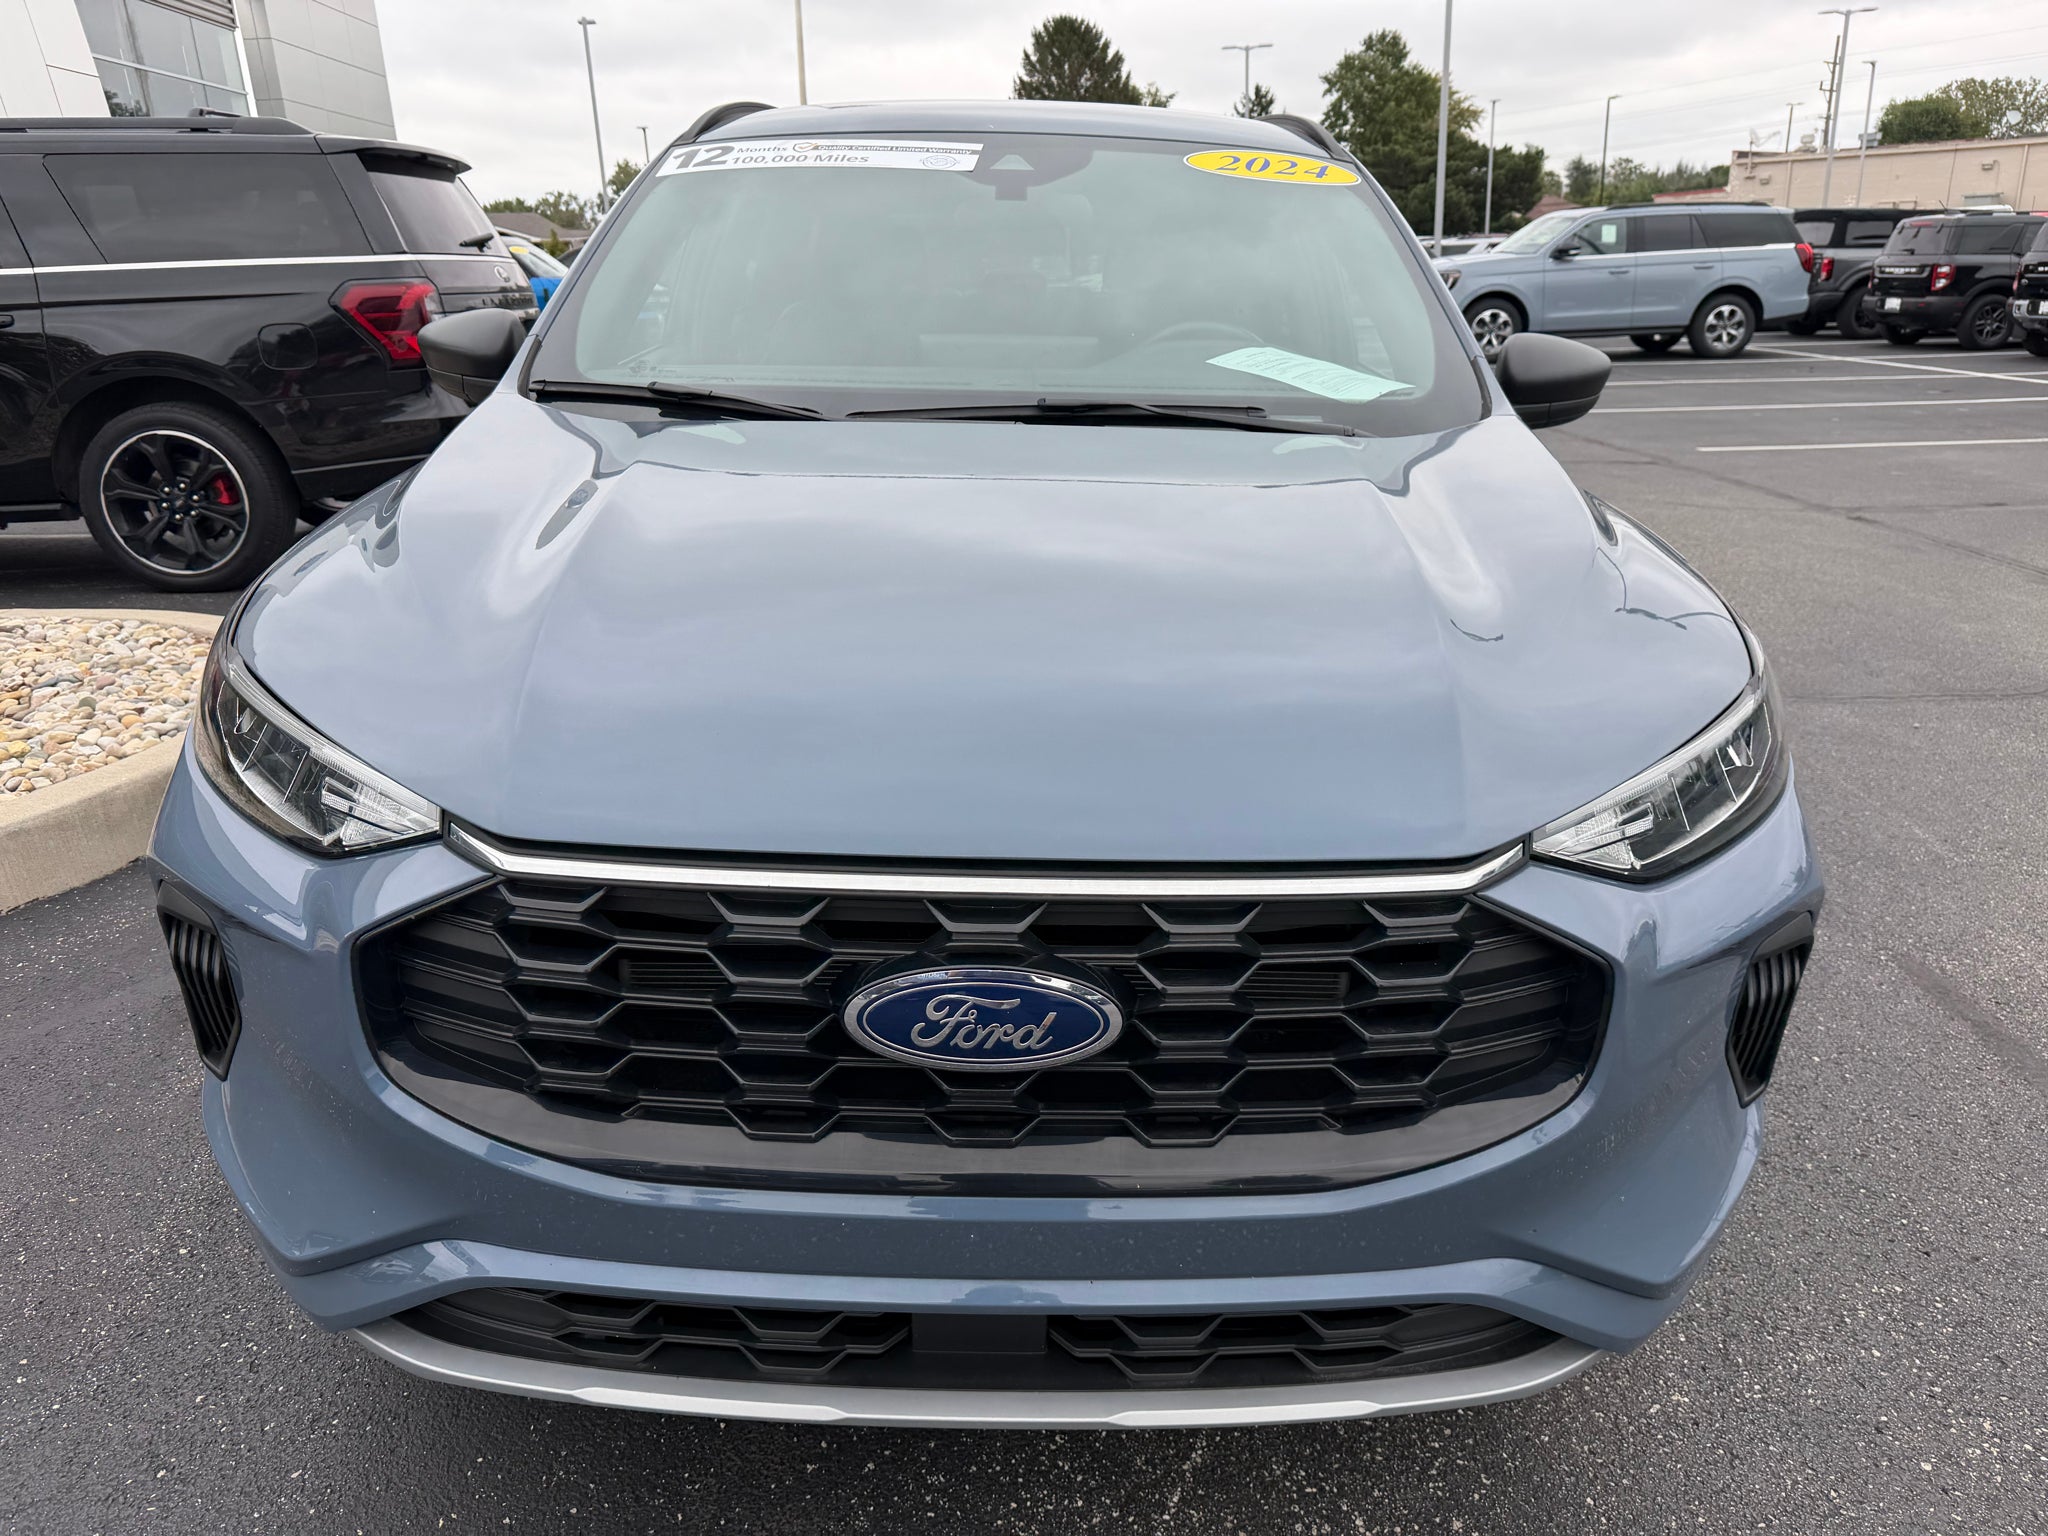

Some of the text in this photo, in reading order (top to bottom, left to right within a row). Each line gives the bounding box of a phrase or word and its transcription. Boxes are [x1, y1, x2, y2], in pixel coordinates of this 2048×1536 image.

[673, 145, 735, 170] 12
[736, 146, 788, 154] Months
[929, 147, 972, 155] Warranty
[732, 154, 870, 164] 100,000 Miles
[1215, 155, 1329, 179] 2024
[911, 994, 1057, 1050] Ford
